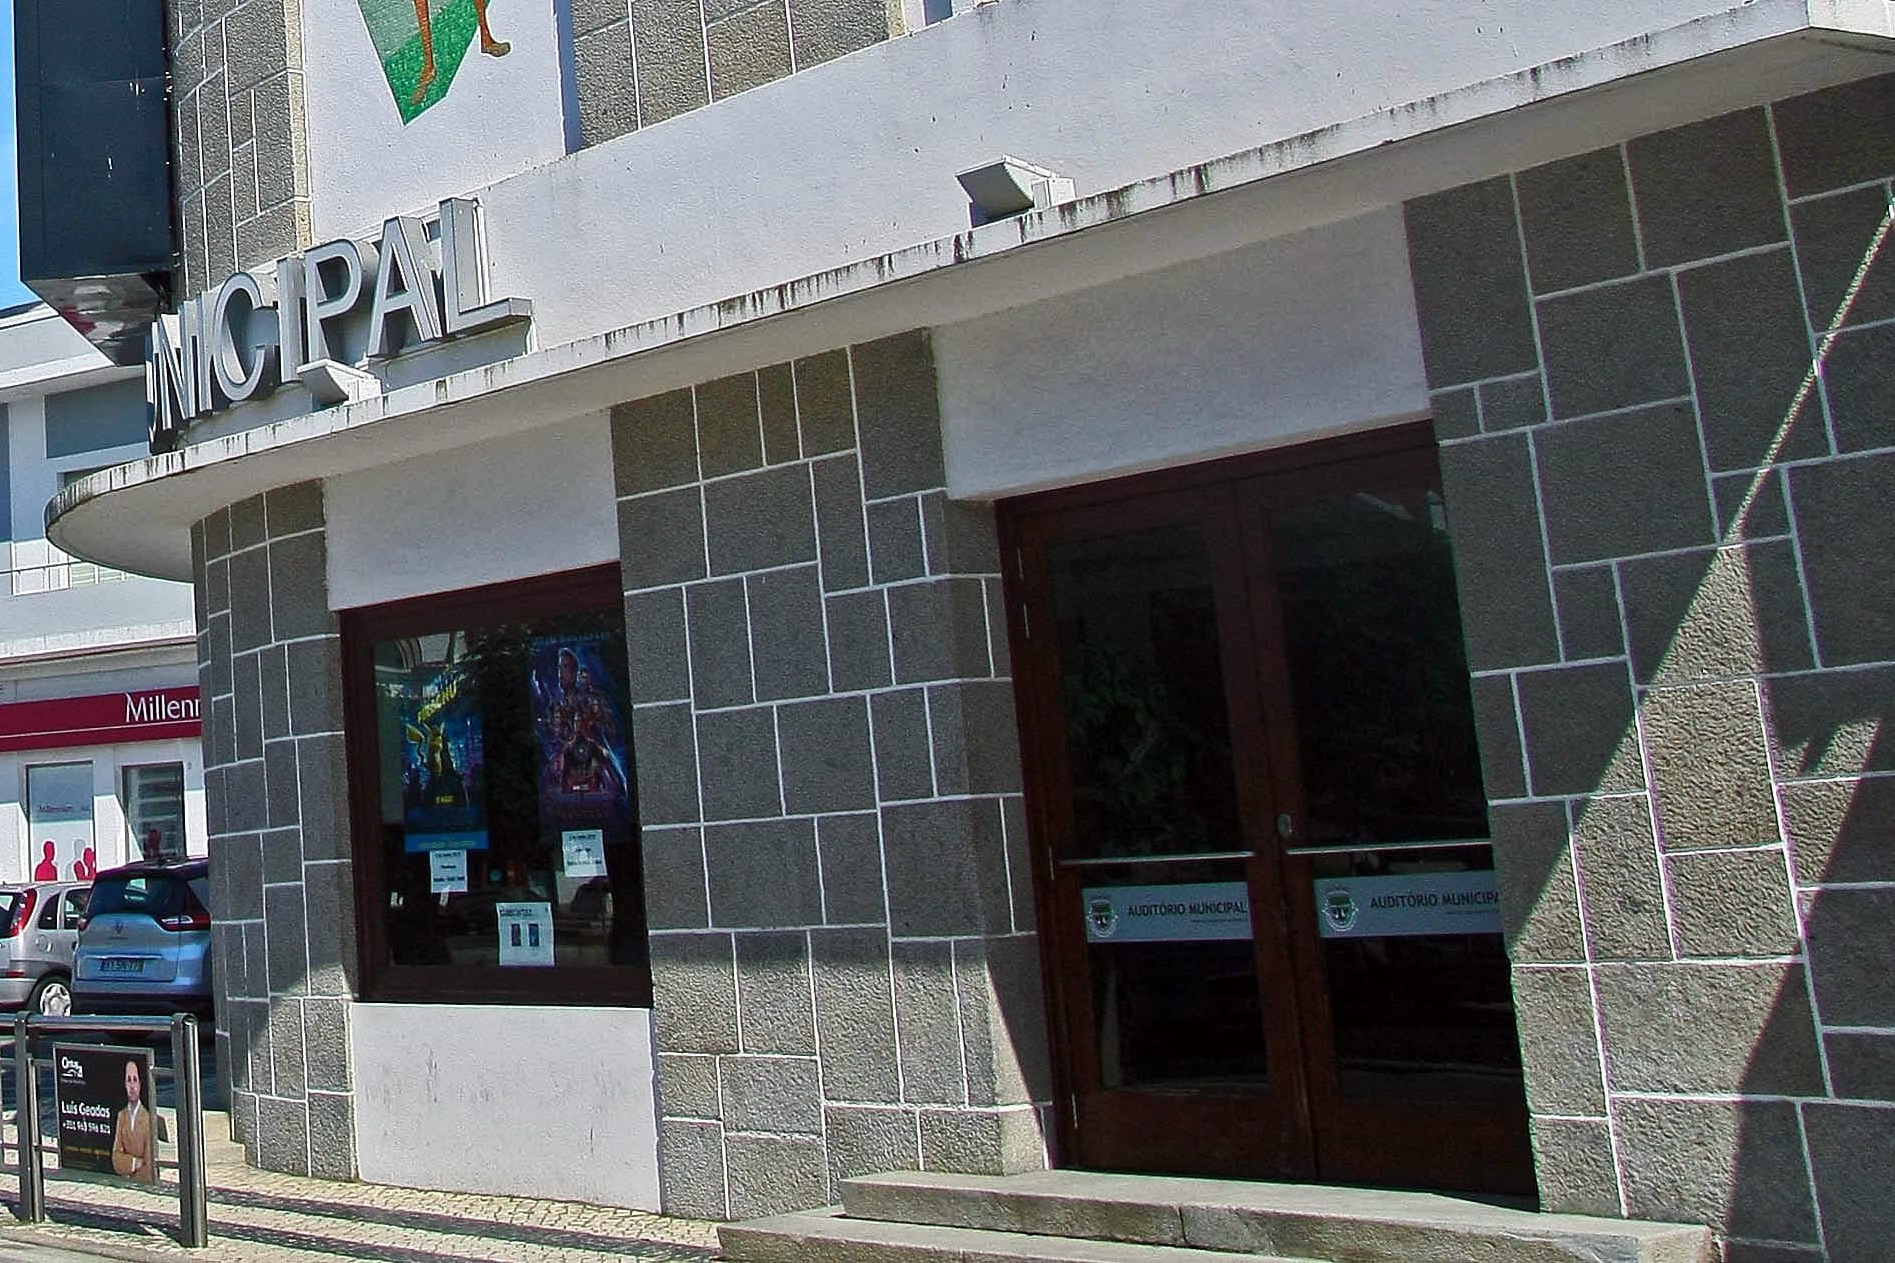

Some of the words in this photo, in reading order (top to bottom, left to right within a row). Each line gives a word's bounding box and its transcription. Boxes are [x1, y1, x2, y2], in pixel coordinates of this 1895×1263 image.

[1128, 901, 1186, 917] AUDITÓRIO
[1189, 900, 1248, 915] MUNICIPAL
[1370, 892, 1438, 909] AUDITÓRIO
